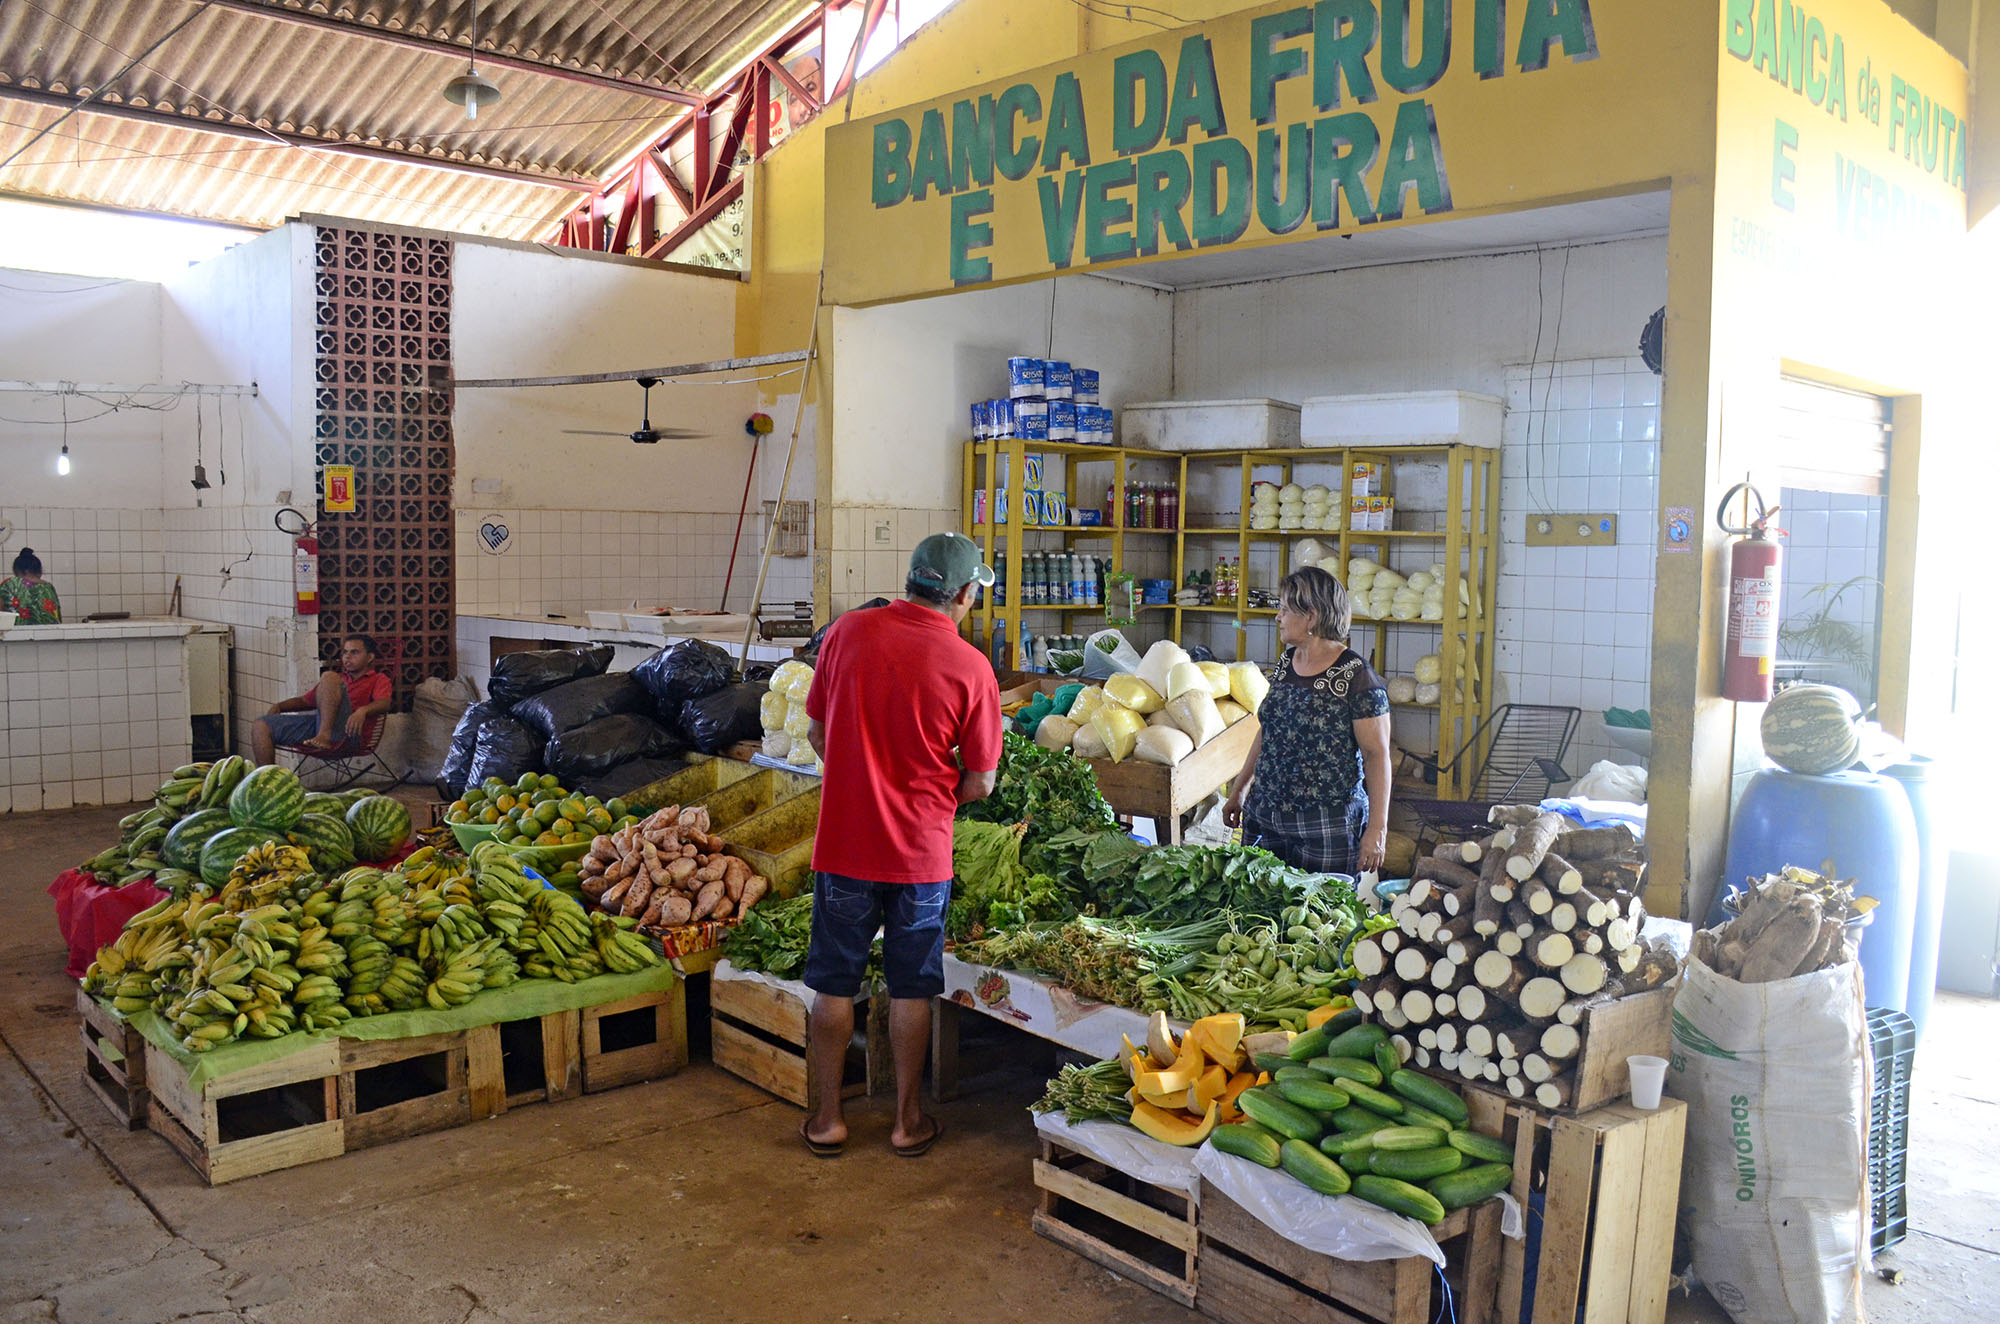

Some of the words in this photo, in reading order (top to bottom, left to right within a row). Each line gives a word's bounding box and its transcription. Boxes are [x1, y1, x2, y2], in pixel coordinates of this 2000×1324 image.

[871, 70, 1091, 209] BANCA
[1113, 33, 1227, 159] DA
[1726, 0, 1847, 123] BANCA
[1857, 56, 1880, 126] da
[1889, 73, 1967, 196] FRUTA
[1771, 117, 1798, 213] E
[949, 190, 994, 287] E
[1037, 99, 1456, 269] VERDURA
[1730, 1094, 1757, 1202] ONIVOROS
